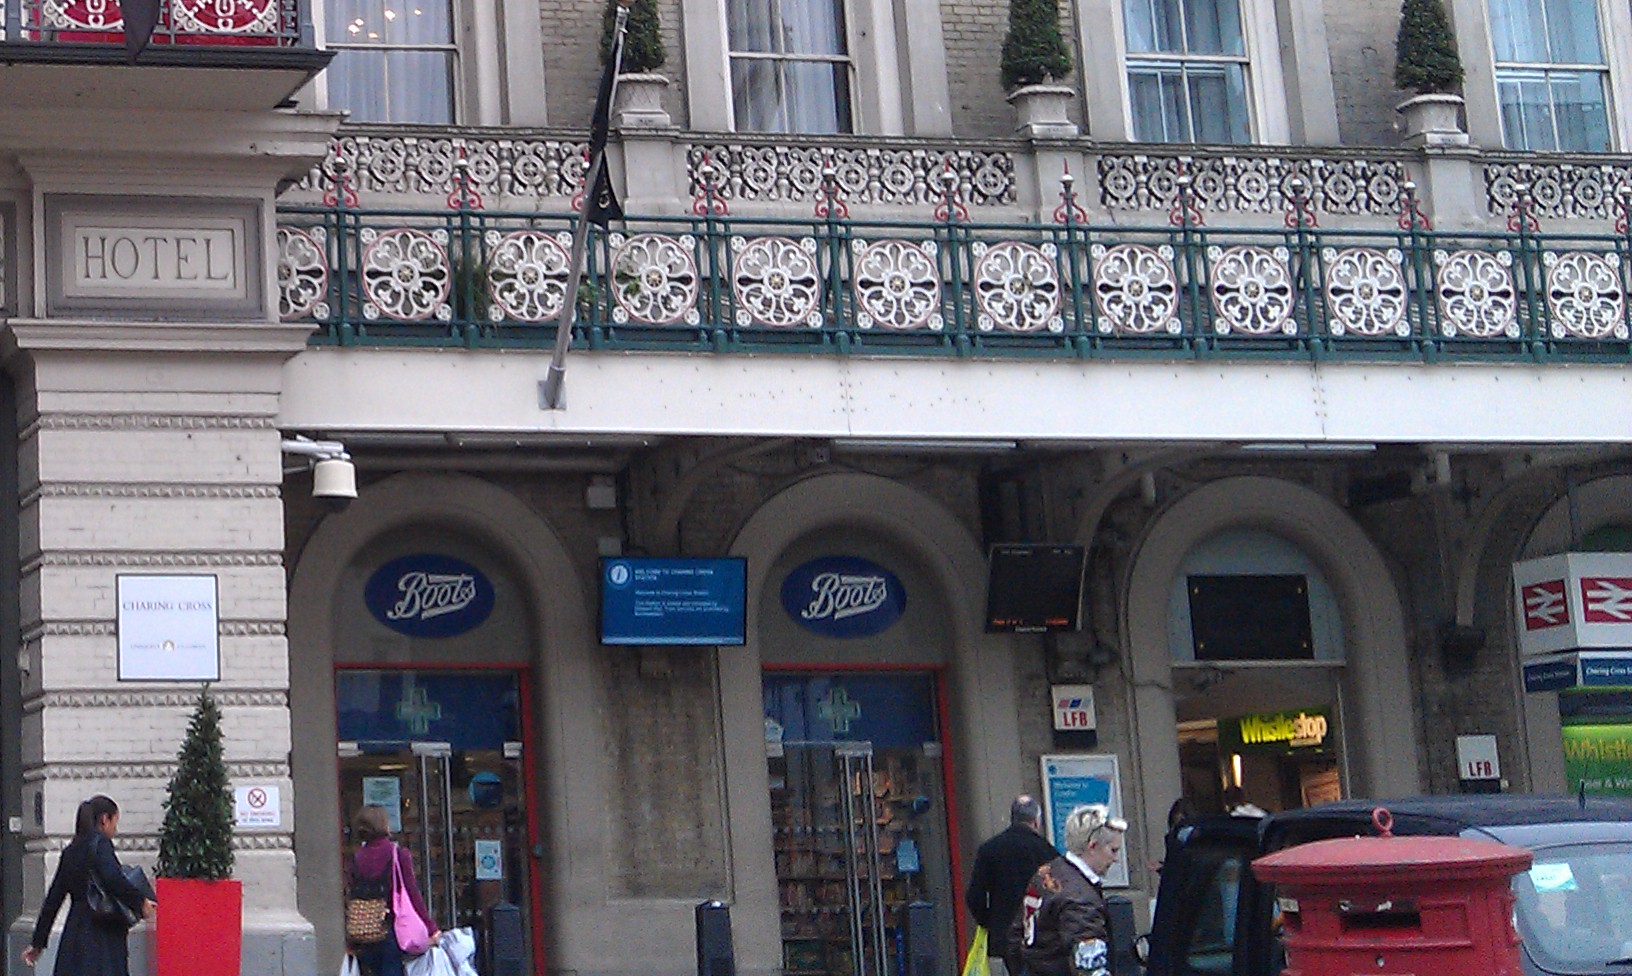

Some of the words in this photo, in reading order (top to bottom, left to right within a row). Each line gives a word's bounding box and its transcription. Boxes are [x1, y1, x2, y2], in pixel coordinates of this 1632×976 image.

[82, 236, 229, 280] HOTEL
[122, 601, 174, 611] CHARING
[178, 601, 213, 611] CROSS
[387, 572, 476, 620] Boots
[801, 572, 888, 621] Boots
